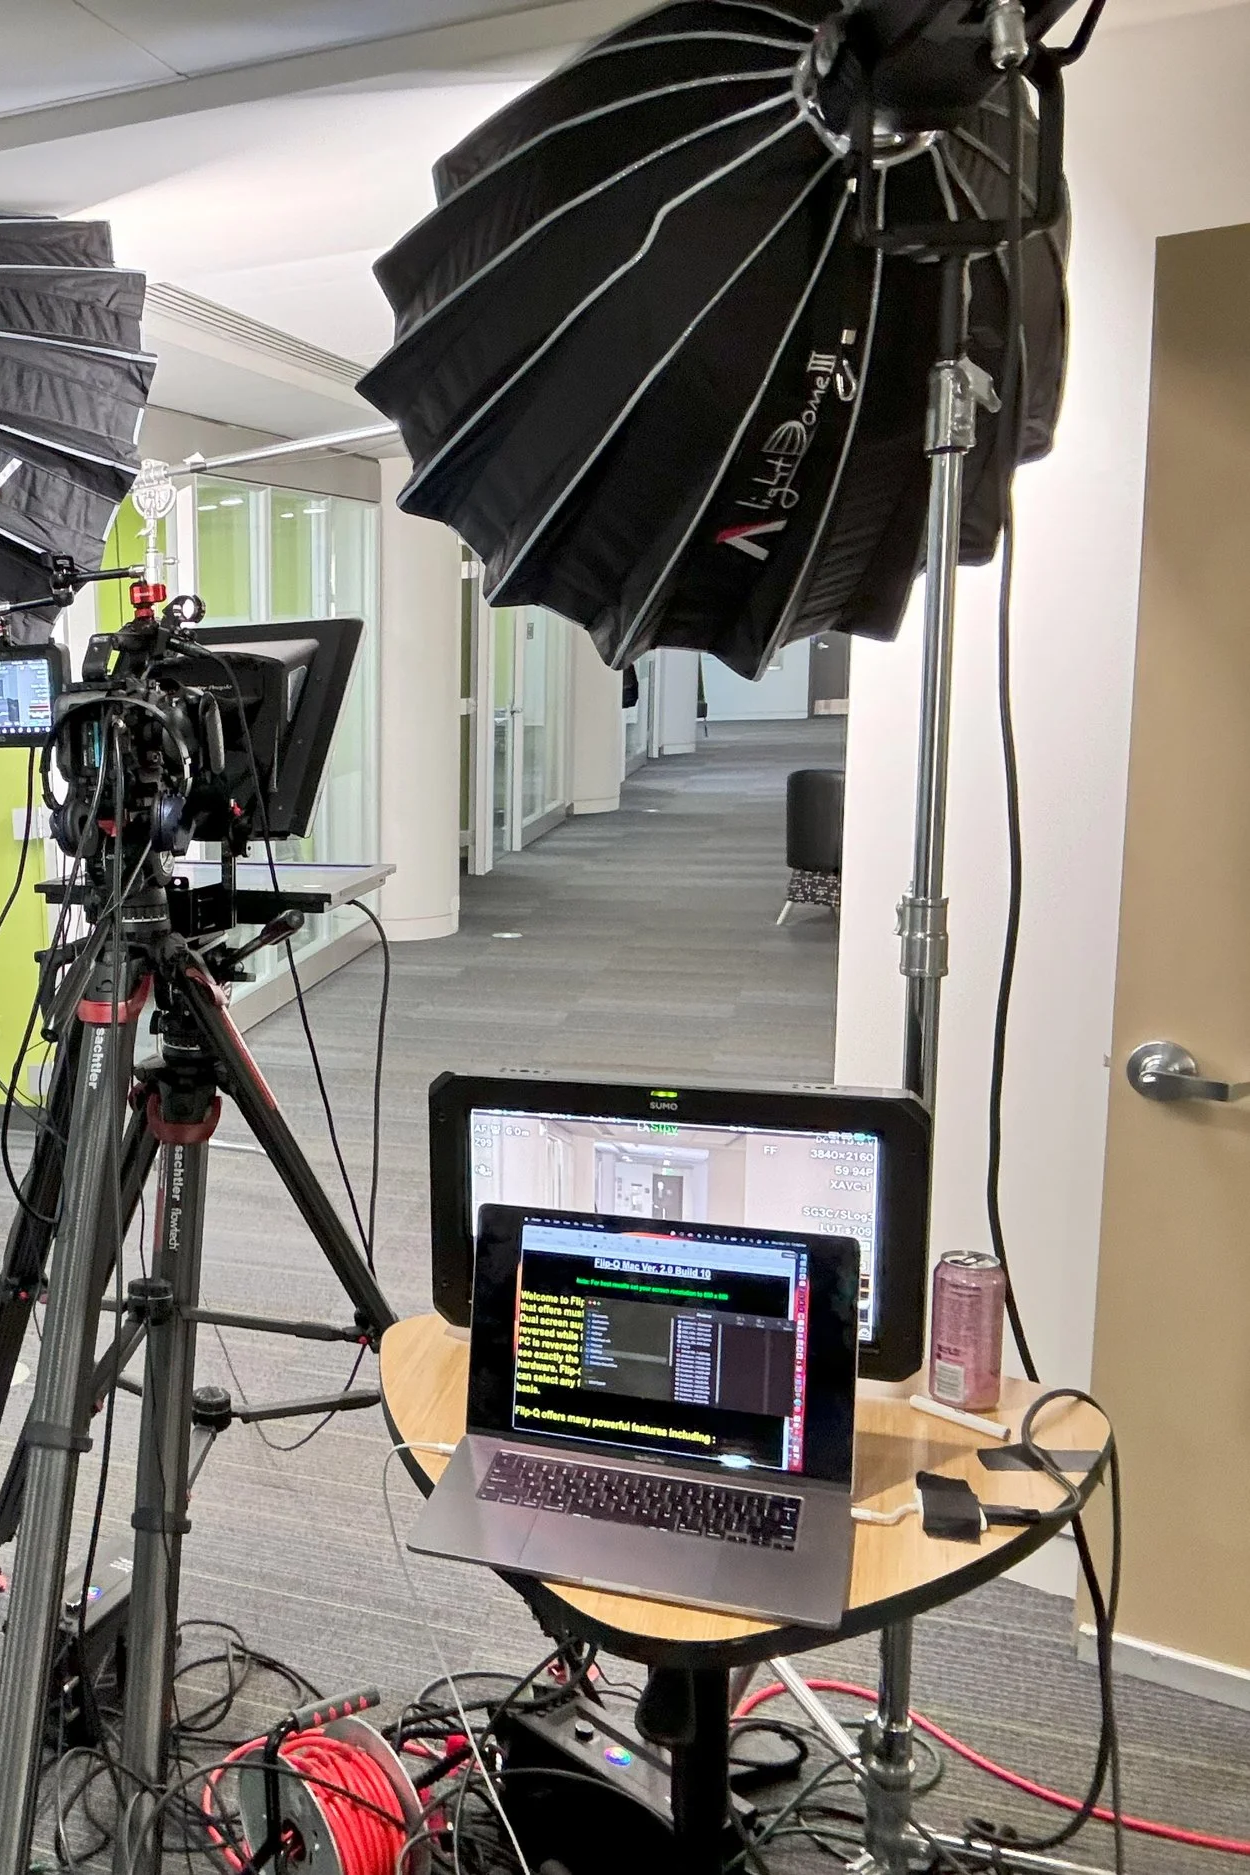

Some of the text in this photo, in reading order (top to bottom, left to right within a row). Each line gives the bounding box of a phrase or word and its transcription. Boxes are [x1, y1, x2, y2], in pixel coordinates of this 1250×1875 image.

[807, 351, 837, 374] III
[88, 1027, 105, 1090] sachtler
[649, 1102, 678, 1111] SUMO
[474, 1125, 487, 1133] AF
[763, 1146, 778, 1155] FF
[168, 1144, 184, 1251] sachtler flowtech
[594, 1258, 620, 1270] Flip-Q
[621, 1261, 640, 1271] Mac
[660, 1265, 673, 1275] 2.0
[675, 1266, 698, 1278] Build
[700, 1269, 711, 1280] 10
[521, 1290, 558, 1304] Welcome
[560, 1295, 569, 1305] to
[520, 1302, 536, 1311] that
[538, 1304, 562, 1315] offers
[520, 1313, 538, 1323] Dual
[540, 1317, 568, 1327] screen
[519, 1326, 578, 1340] reversed while
[518, 1336, 578, 1352] PC is reversed
[518, 1348, 579, 1364] see exactly the
[517, 1359, 558, 1373] hardware.
[516, 1371, 532, 1380] can
[533, 1374, 558, 1384] select
[559, 1378, 575, 1388] any
[516, 1382, 541, 1394] basis.
[515, 1405, 540, 1418] Flip-Q
[541, 1409, 566, 1422] offers
[567, 1414, 591, 1427] many
[592, 1417, 630, 1431] powerful
[631, 1422, 667, 1437] features
[668, 1428, 711, 1445] including
